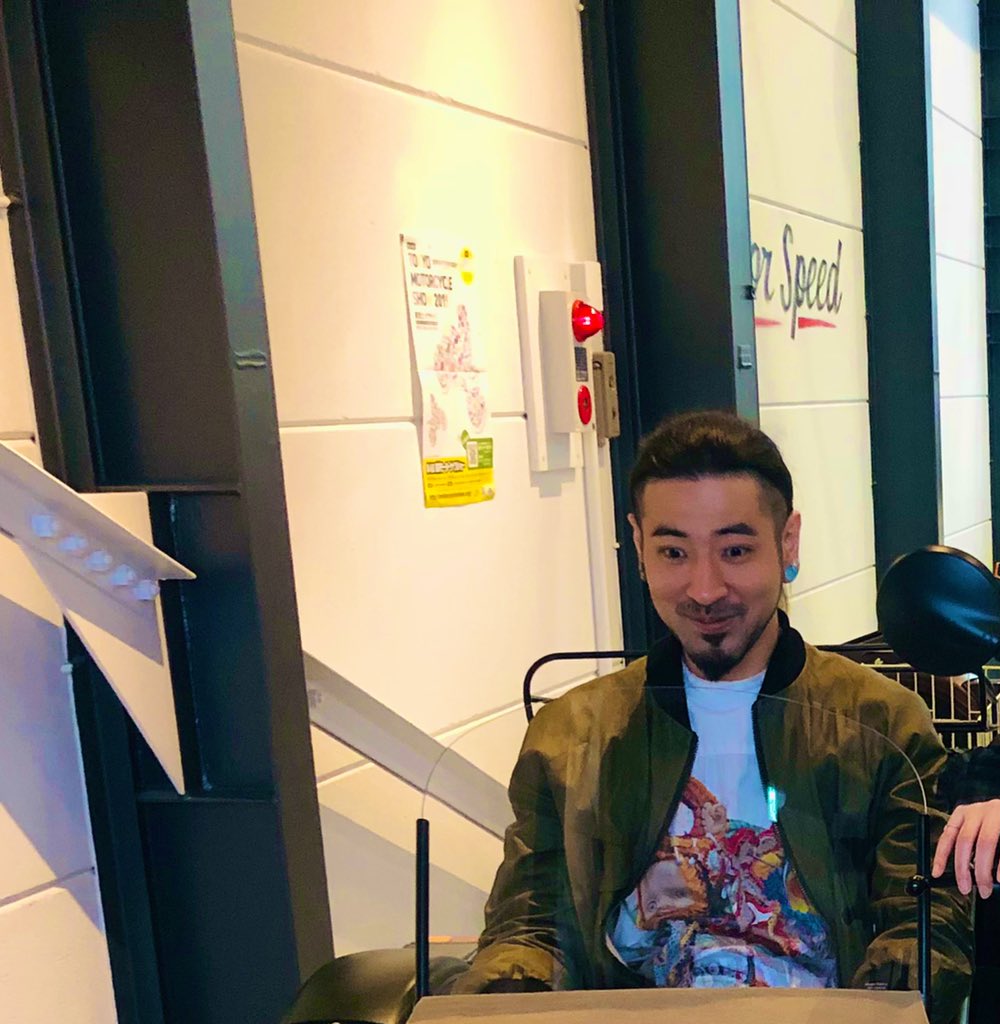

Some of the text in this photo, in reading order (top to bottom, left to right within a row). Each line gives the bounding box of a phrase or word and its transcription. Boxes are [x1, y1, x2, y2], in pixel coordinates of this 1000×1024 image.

[407, 252, 431, 270] TOYO
[410, 271, 453, 292] MOTORCYCLE
[780, 223, 843, 341] Speed
[412, 291, 432, 306] SHO
